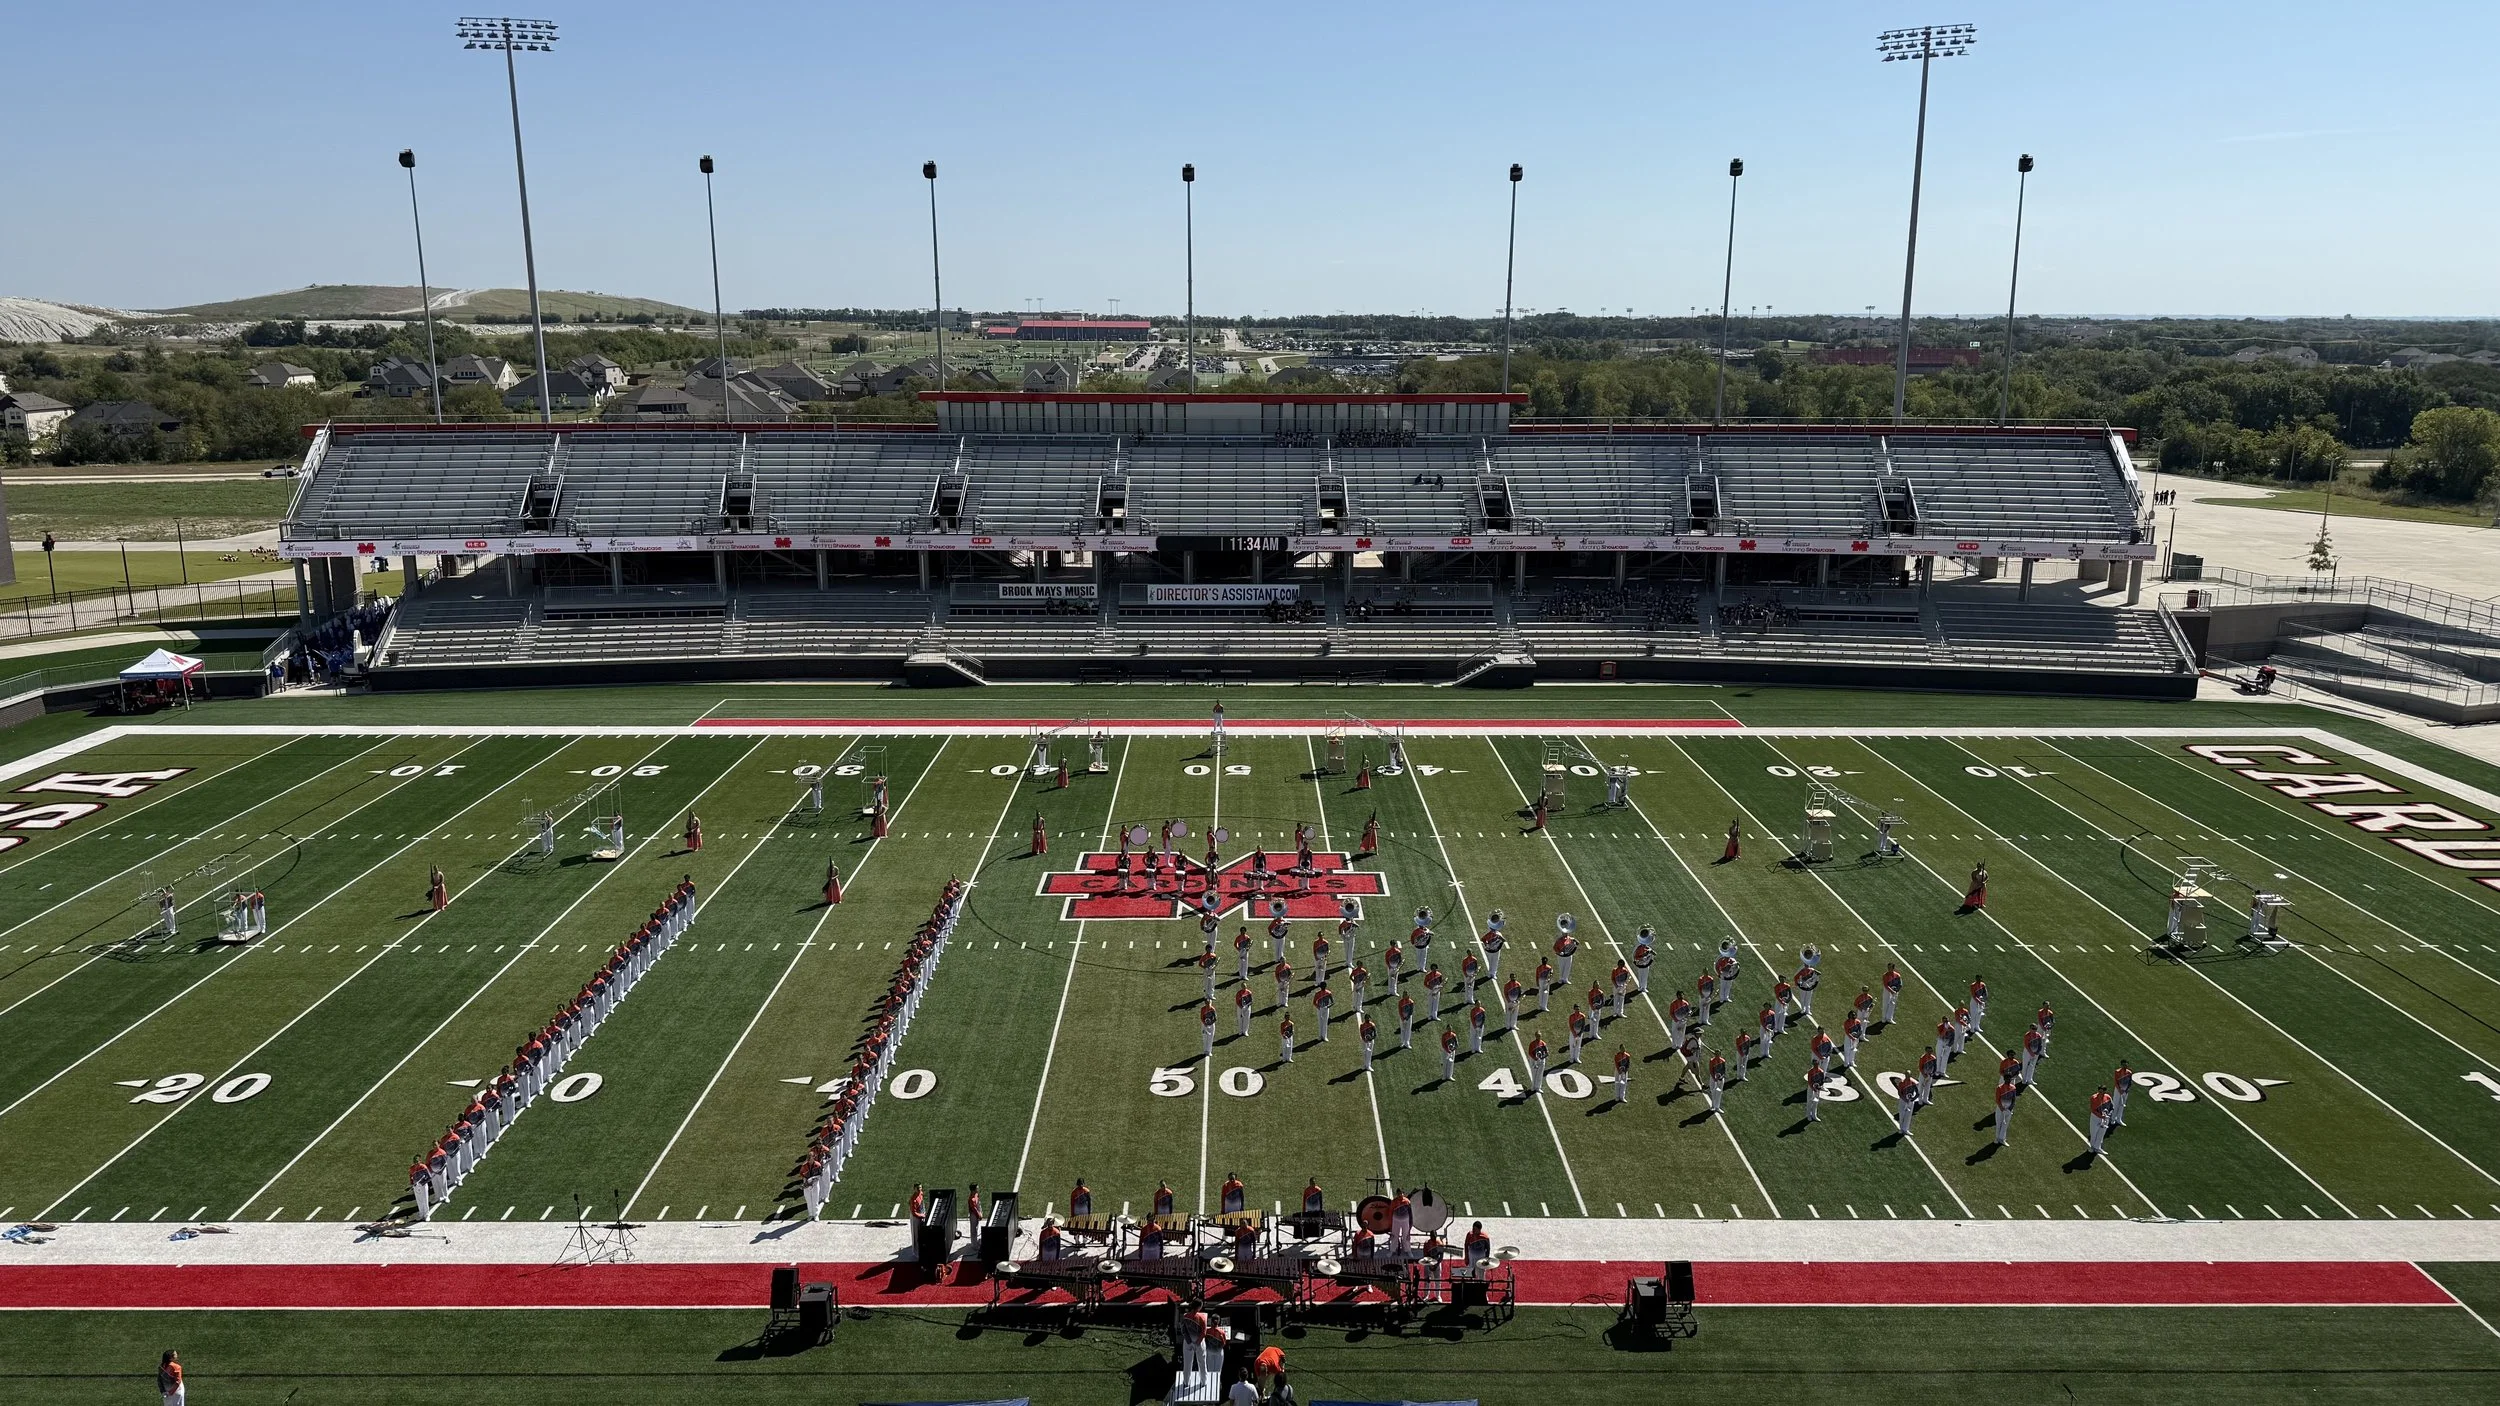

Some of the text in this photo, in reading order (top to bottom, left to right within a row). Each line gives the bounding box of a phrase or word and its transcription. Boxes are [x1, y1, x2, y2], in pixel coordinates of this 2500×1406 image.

[1230, 537, 1279, 550] 11:34 AM
[1002, 586, 1095, 596] BROOK MAYS MUSIC
[1156, 588, 1299, 601] DIRECTOR'S ASSISTANT.COM
[1183, 765, 1252, 776] 50
[129, 1073, 272, 1104] 20
[1150, 1066, 1264, 1097] 50
[1478, 1068, 1593, 1099] 40
[2131, 1072, 2262, 1102] 20
